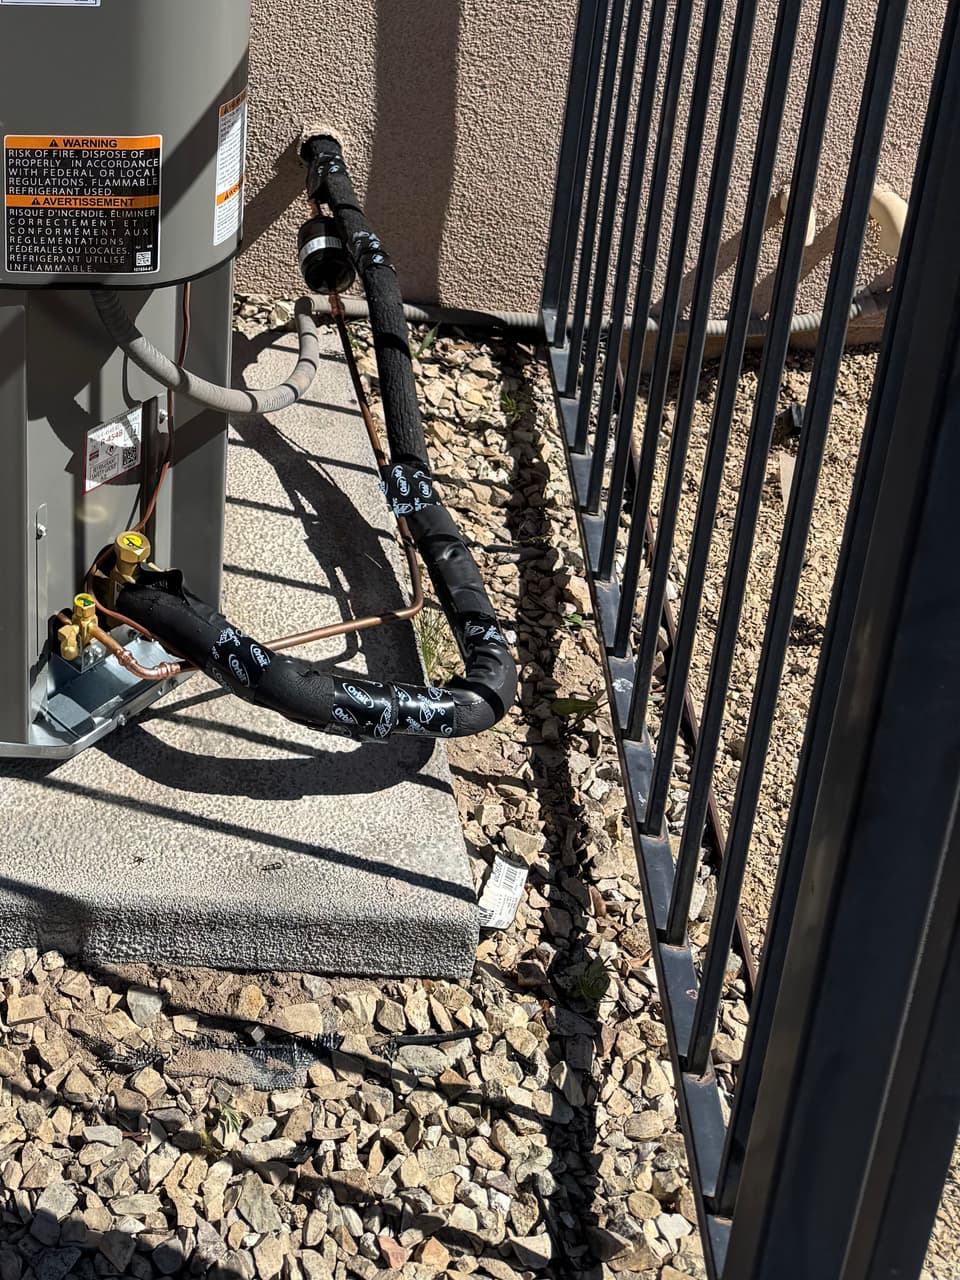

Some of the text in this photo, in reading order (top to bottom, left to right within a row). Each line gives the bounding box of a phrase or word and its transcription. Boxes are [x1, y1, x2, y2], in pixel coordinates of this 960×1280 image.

[63, 140, 118, 148] WARNING
[8, 150, 145, 159] RISK OF FIRE. DISPOSE OF
[8, 159, 159, 168] PROPERLY IN ACCORDANCE
[8, 168, 157, 178] WITH FEDERAL OR LOCAL
[8, 177, 158, 187] REGULATIONS. FLAMMABLE
[8, 186, 115, 196] REFRIGERANT USED.
[42, 197, 135, 207] AVERTISSEMENT
[9, 208, 44, 217] RISQUE
[110, 208, 156, 217] ÉLIMINER
[9, 218, 138, 228] CORRECTEMENT ET
[124, 228, 149, 236] AUX
[9, 244, 63, 254] FÉDÉRALES
[66, 246, 81, 254] OU
[84, 246, 130, 255] LOCALES.
[9, 263, 96, 272] INFLAMMABLE.
[253, 647, 268, 668] Orbit
[231, 659, 247, 682] Orbit
[347, 685, 370, 705] Orbit
